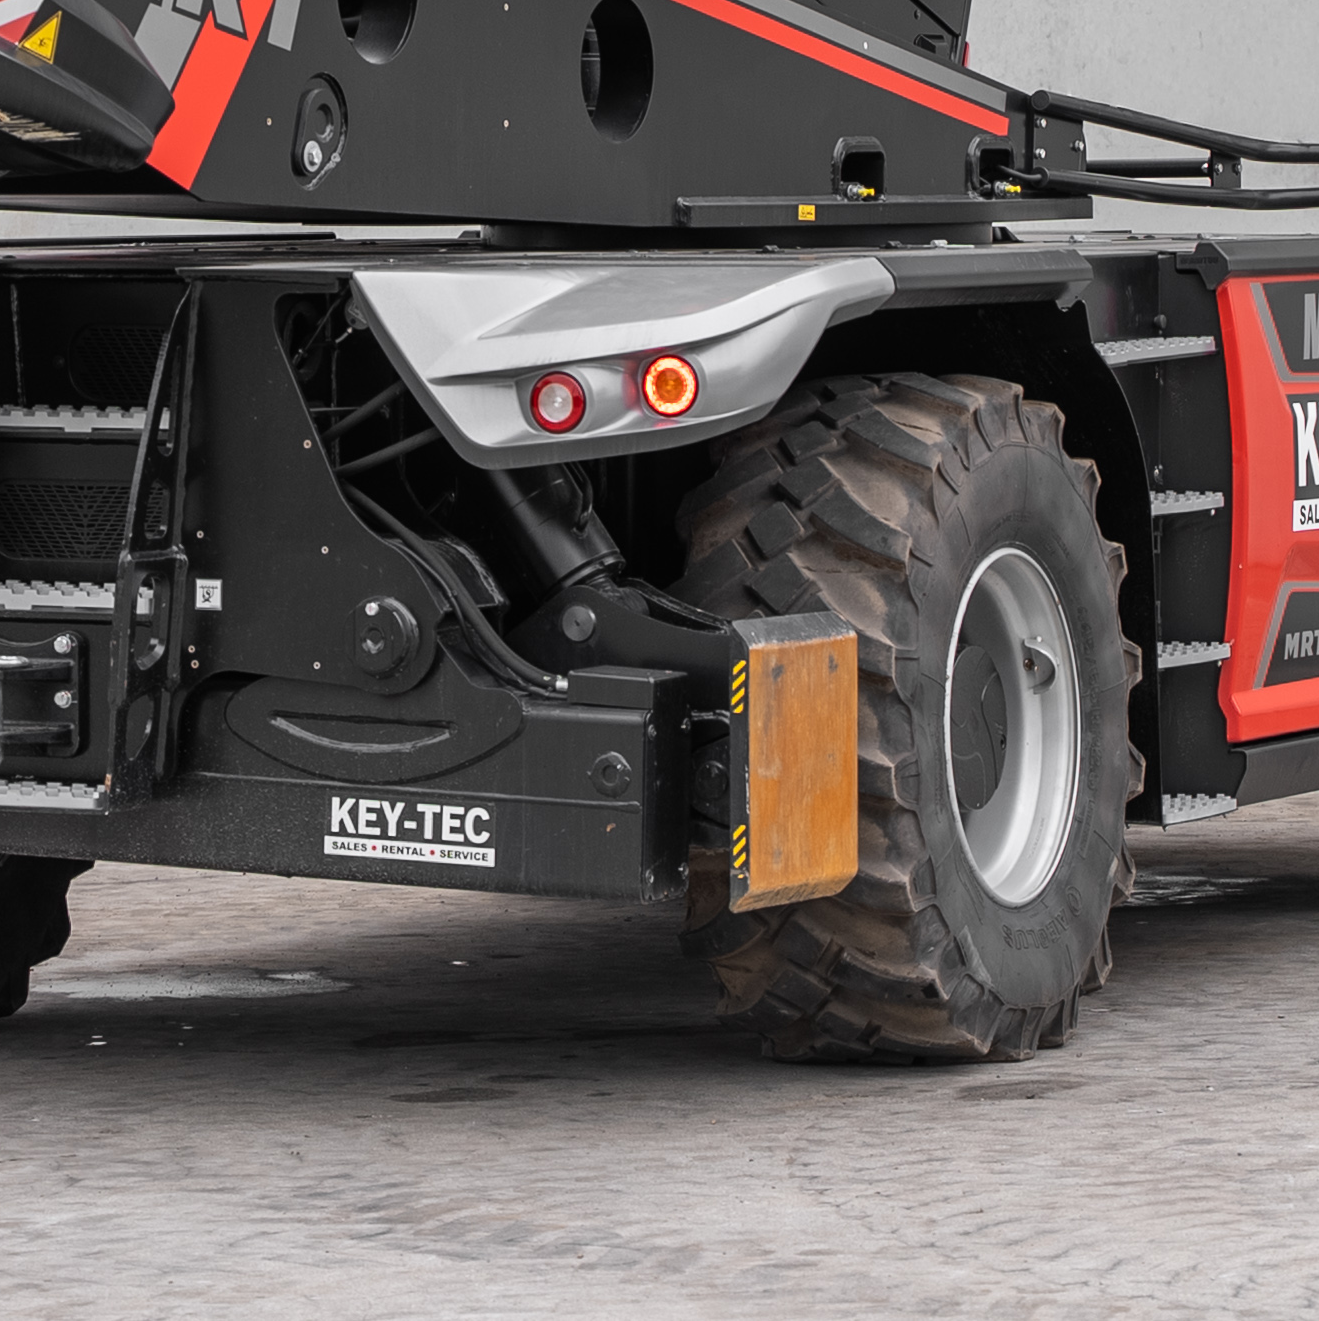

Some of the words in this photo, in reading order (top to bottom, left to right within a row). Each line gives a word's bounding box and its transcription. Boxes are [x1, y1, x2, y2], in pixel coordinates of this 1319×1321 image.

[331, 796, 491, 844] KEY-TEC
[332, 841, 368, 852] SALES
[381, 844, 426, 857] RENTAL
[439, 849, 489, 862] SERVICE
